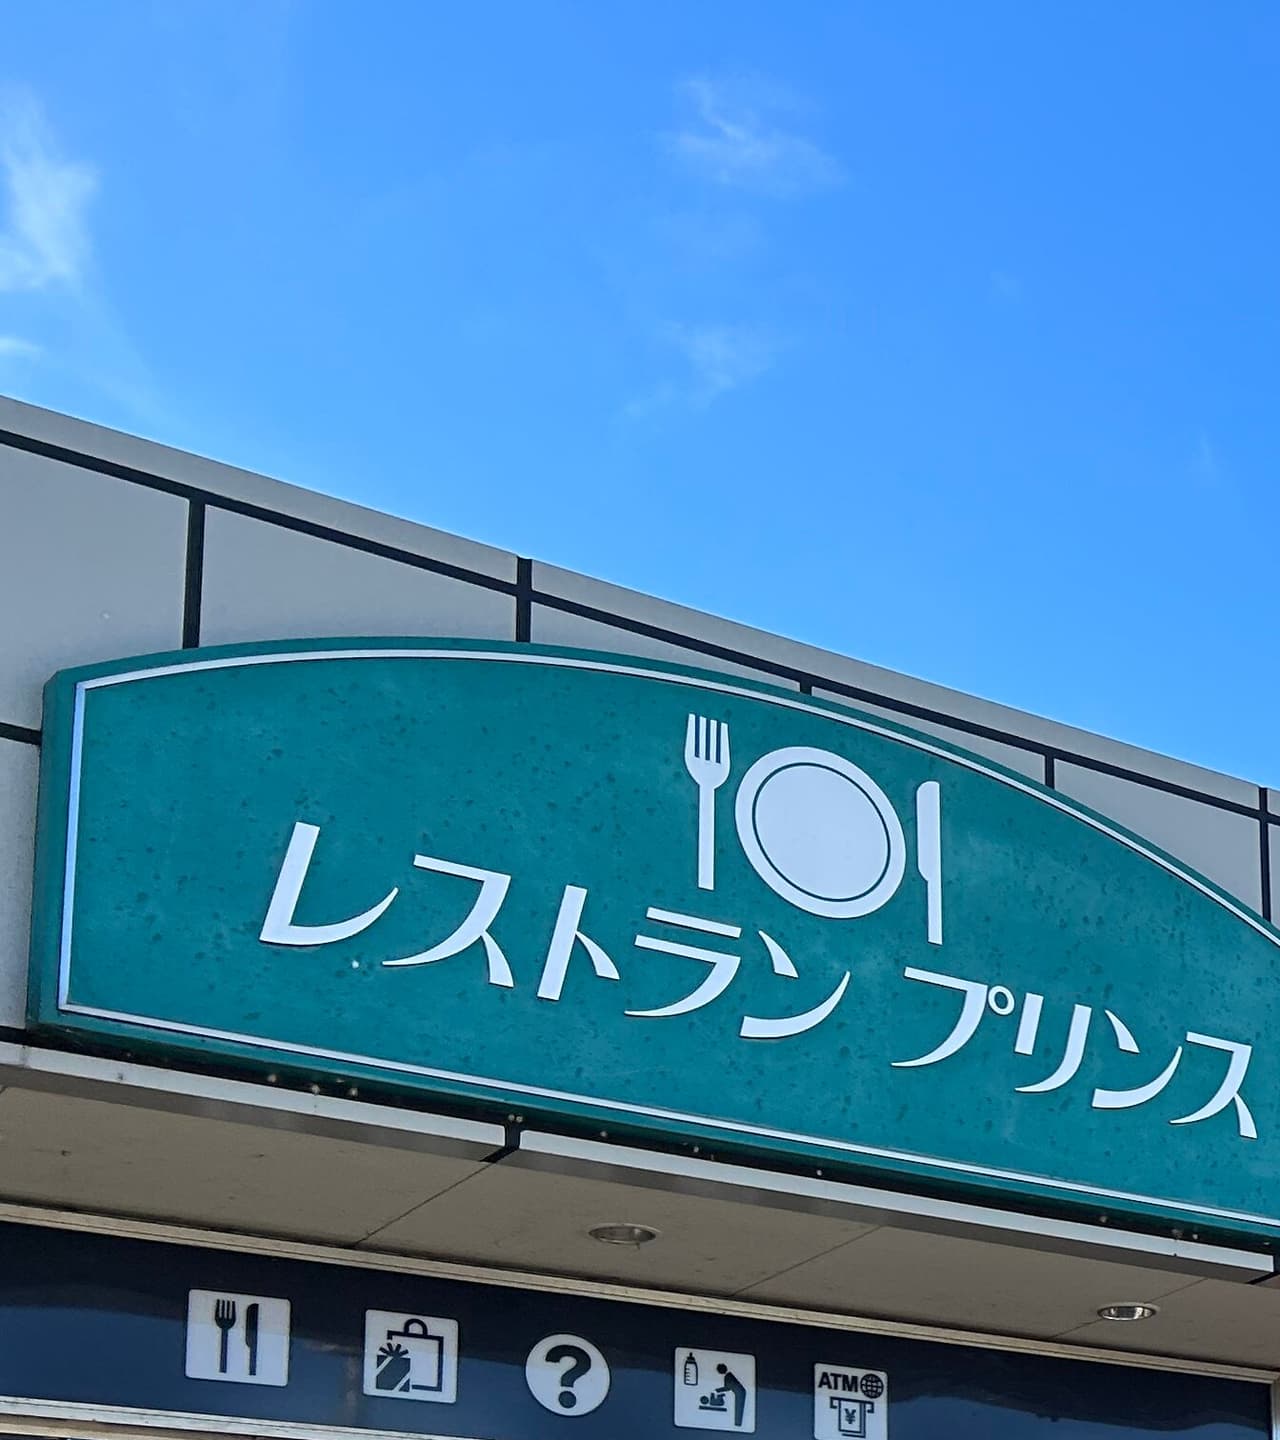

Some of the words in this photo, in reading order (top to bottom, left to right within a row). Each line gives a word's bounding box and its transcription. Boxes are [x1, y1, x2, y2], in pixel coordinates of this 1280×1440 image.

[258, 820, 852, 1041] レストラン
[891, 965, 1260, 1140] プリンス
[817, 1370, 861, 1394] ATM
